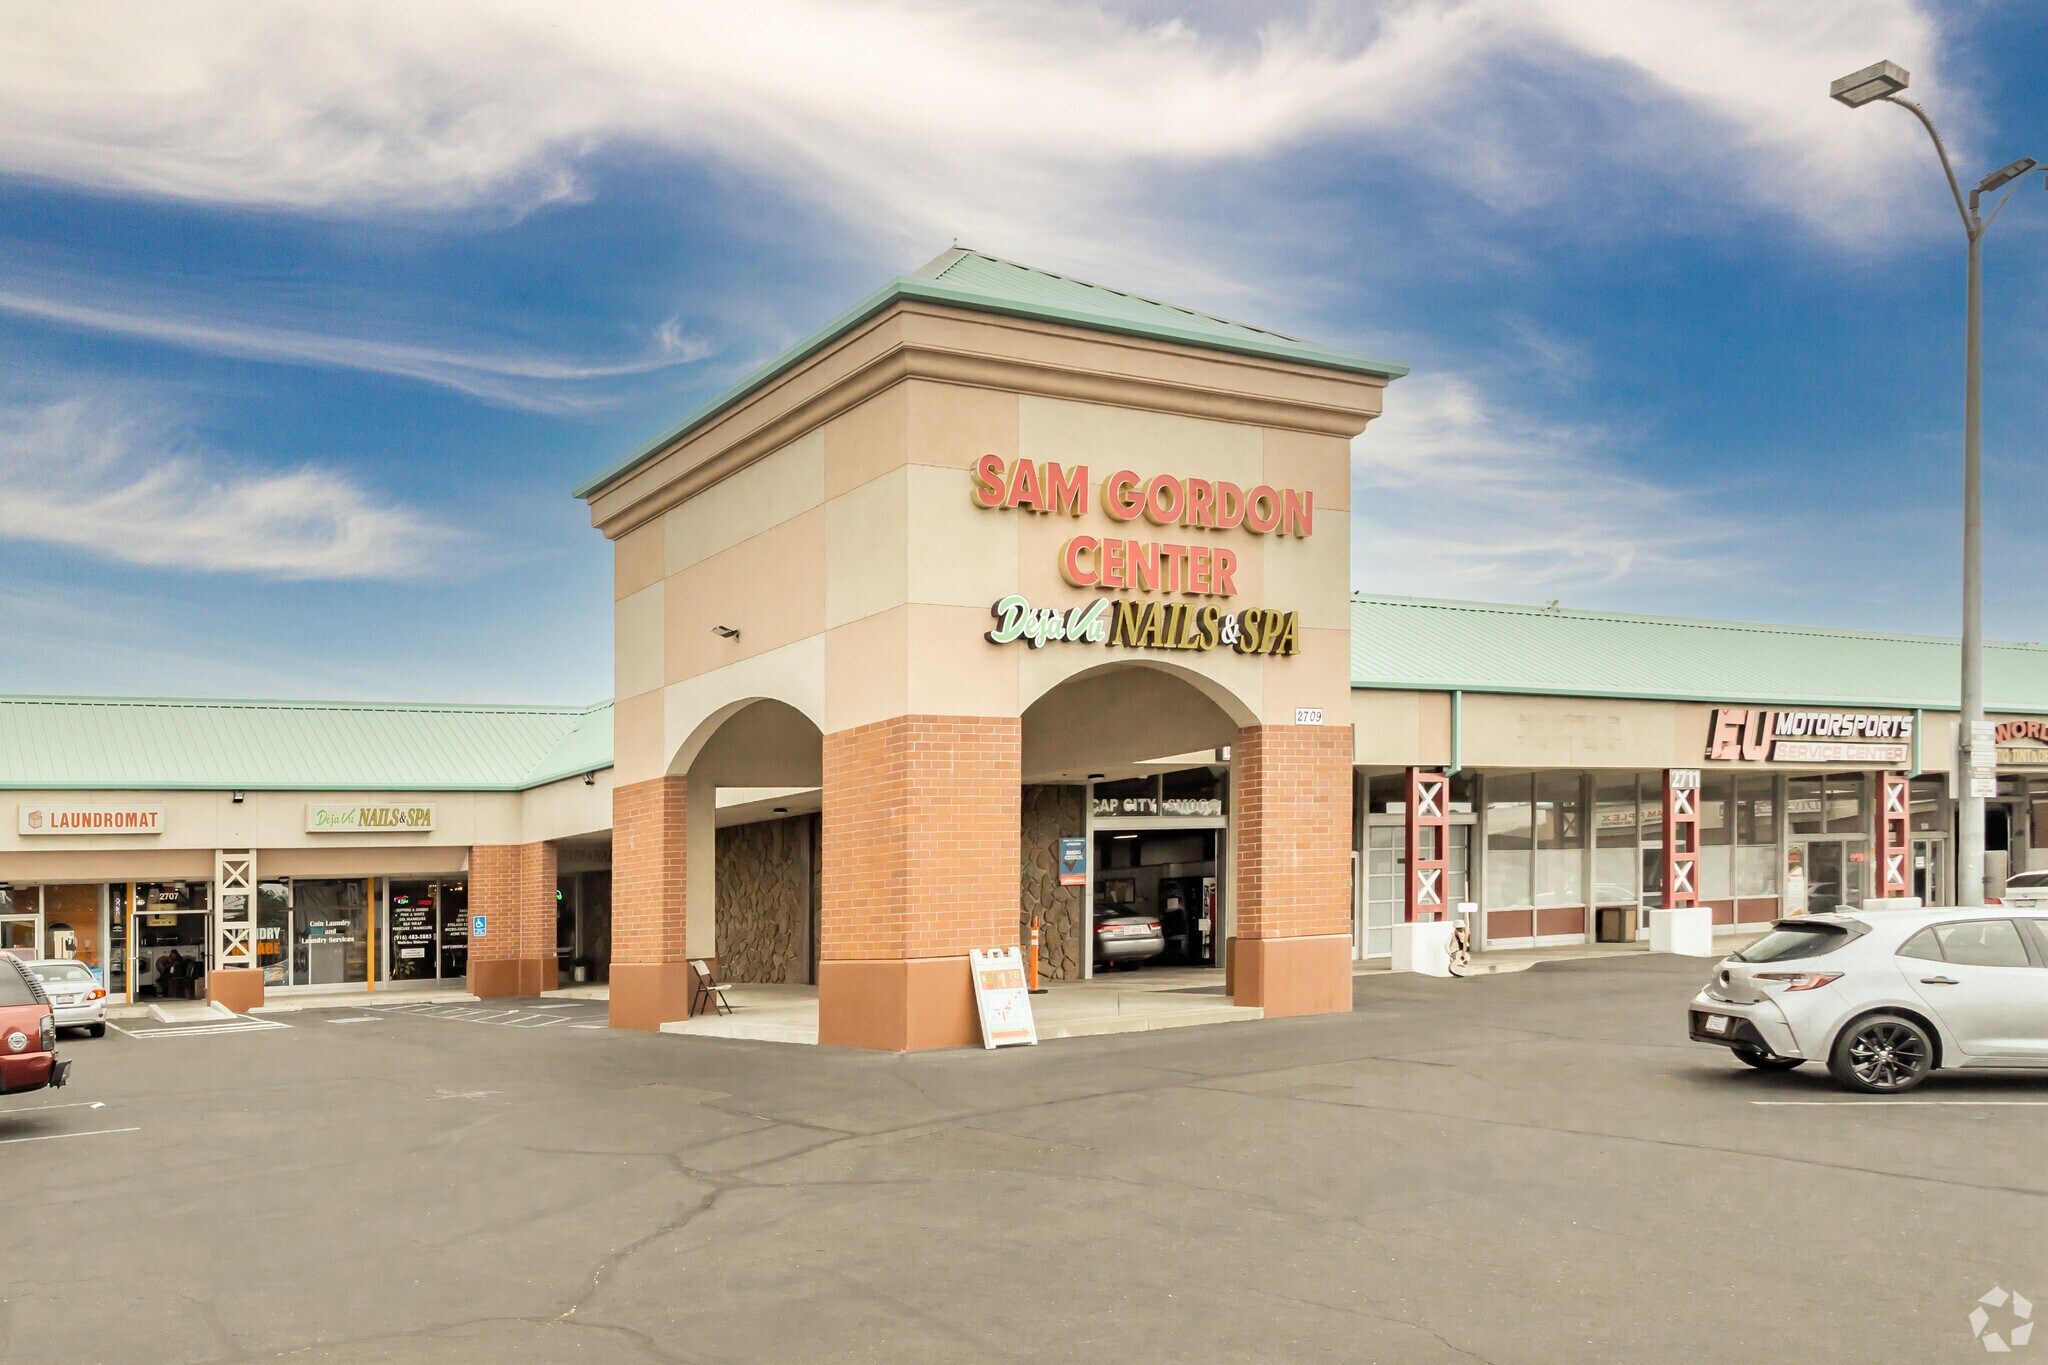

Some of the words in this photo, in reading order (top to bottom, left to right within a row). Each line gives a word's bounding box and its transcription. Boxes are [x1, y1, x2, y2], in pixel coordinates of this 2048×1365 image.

[971, 453, 1089, 517] SAM
[1101, 469, 1314, 538] GORDON
[1058, 535, 1238, 597] CENTER
[1064, 597, 1110, 643] Vu
[1297, 710, 1322, 722] 2709
[1774, 711, 1914, 738] MOTORSPORTS
[1707, 709, 1775, 761] EU
[1776, 743, 1842, 760] SERVICE
[1844, 745, 1904, 760] CENTER
[1671, 770, 1700, 788] 2711
[1123, 798, 1157, 812] CITY
[50, 812, 158, 828] LAUNDROMAT
[341, 808, 355, 824] Vu
[159, 892, 179, 900] 2707
